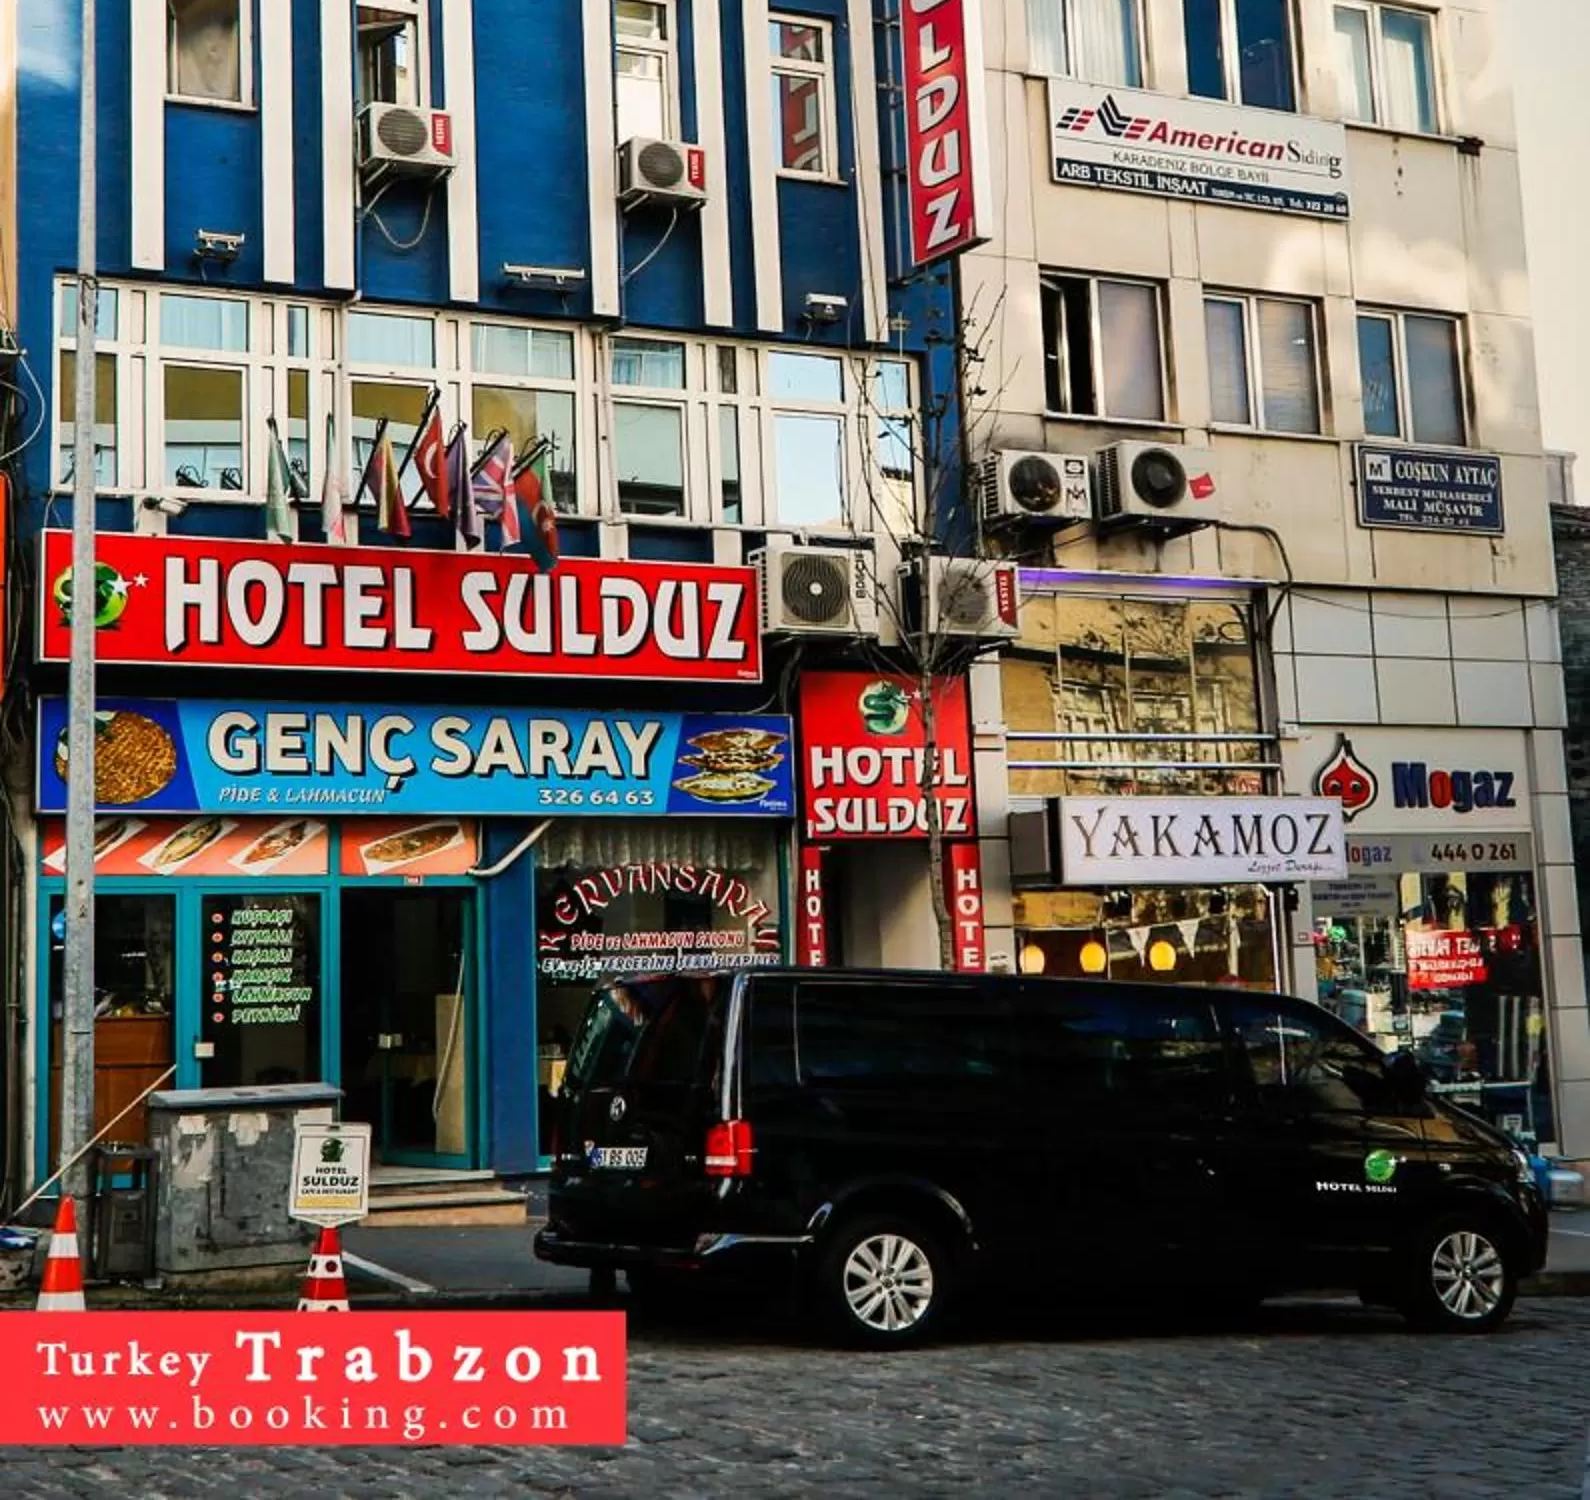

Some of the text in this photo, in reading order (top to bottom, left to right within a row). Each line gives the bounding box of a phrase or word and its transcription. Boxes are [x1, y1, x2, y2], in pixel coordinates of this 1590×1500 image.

[1147, 121, 1286, 161] American
[1061, 162, 1091, 179] ARB
[1395, 460, 1449, 482] COŞKUN
[1454, 465, 1498, 488] AYTAÇ
[164, 555, 748, 660] HOTEL SULDUZ
[207, 710, 664, 792] GENÇ SARAY
[810, 745, 969, 789] HOTEL
[219, 783, 386, 804] PİDE & LAHMACUN
[538, 788, 656, 806] 326 64 63
[1391, 761, 1517, 814] Mogaz
[812, 797, 969, 834] SULDUZ
[1071, 806, 1335, 858] YAKAMOZ
[1345, 841, 1517, 867] ogaz 444 0 261
[804, 869, 825, 968] HOTE
[956, 868, 981, 968] HOTE
[303, 1175, 359, 1187] SULDUZ
[316, 1166, 348, 1175] HOTEL
[1316, 1181, 1362, 1193] HOTEL
